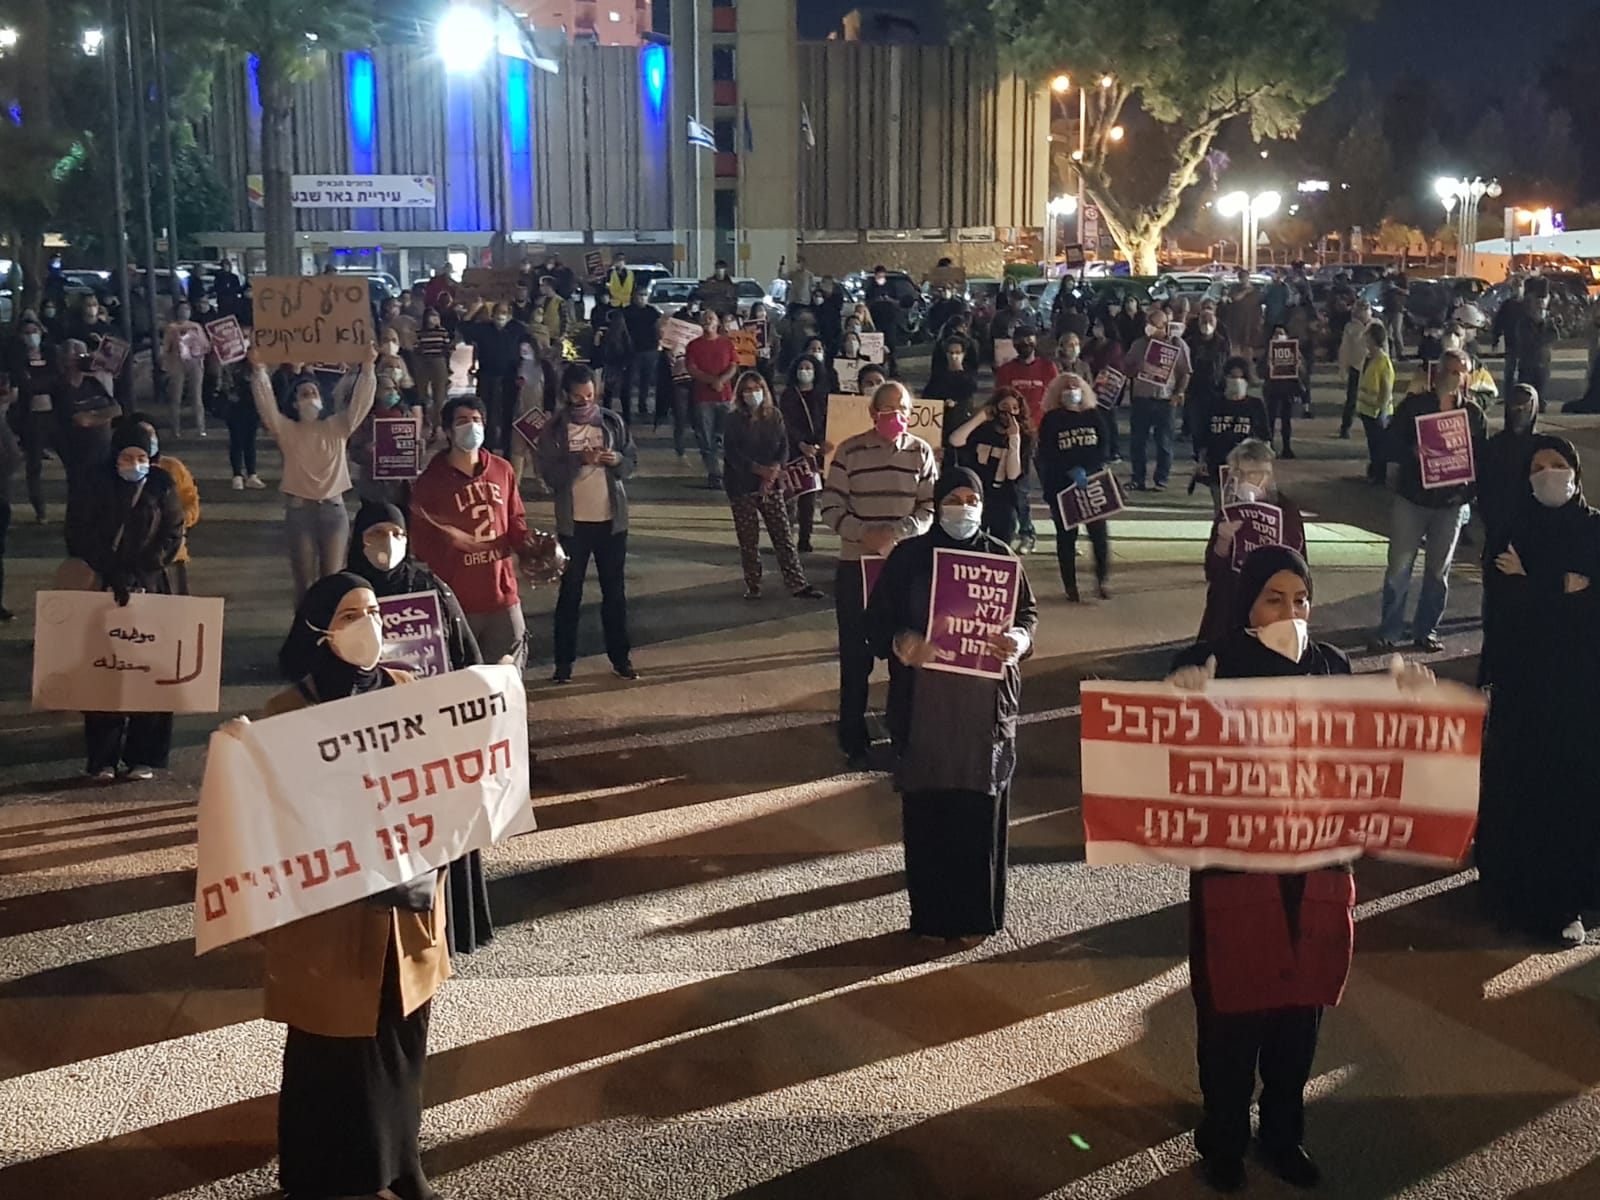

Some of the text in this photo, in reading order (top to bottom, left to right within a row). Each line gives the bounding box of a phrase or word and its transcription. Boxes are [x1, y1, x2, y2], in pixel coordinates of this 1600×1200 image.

[325, 191, 353, 202] באר
[358, 191, 400, 202] עיריית
[336, 318, 364, 345] ולא
[455, 481, 504, 512] LIVE
[472, 504, 497, 543] 2
[1239, 508, 1276, 525] שלטון
[1252, 520, 1276, 538] העם
[952, 563, 1010, 585] שלטון
[968, 583, 1008, 603] העם
[383, 607, 430, 629] حكم
[975, 601, 1005, 620] ולא
[384, 624, 431, 643] الشع
[945, 615, 1003, 636] שלטון
[155, 623, 204, 685] لا
[318, 692, 507, 762] השר אקוניס
[1102, 698, 1466, 752] אנחנו דורשות לקבל
[363, 739, 512, 811] תסתכל
[376, 813, 433, 861] לנו
[1144, 807, 1414, 851] כפי שמגיע לנו!
[202, 840, 361, 921] בעיניים
